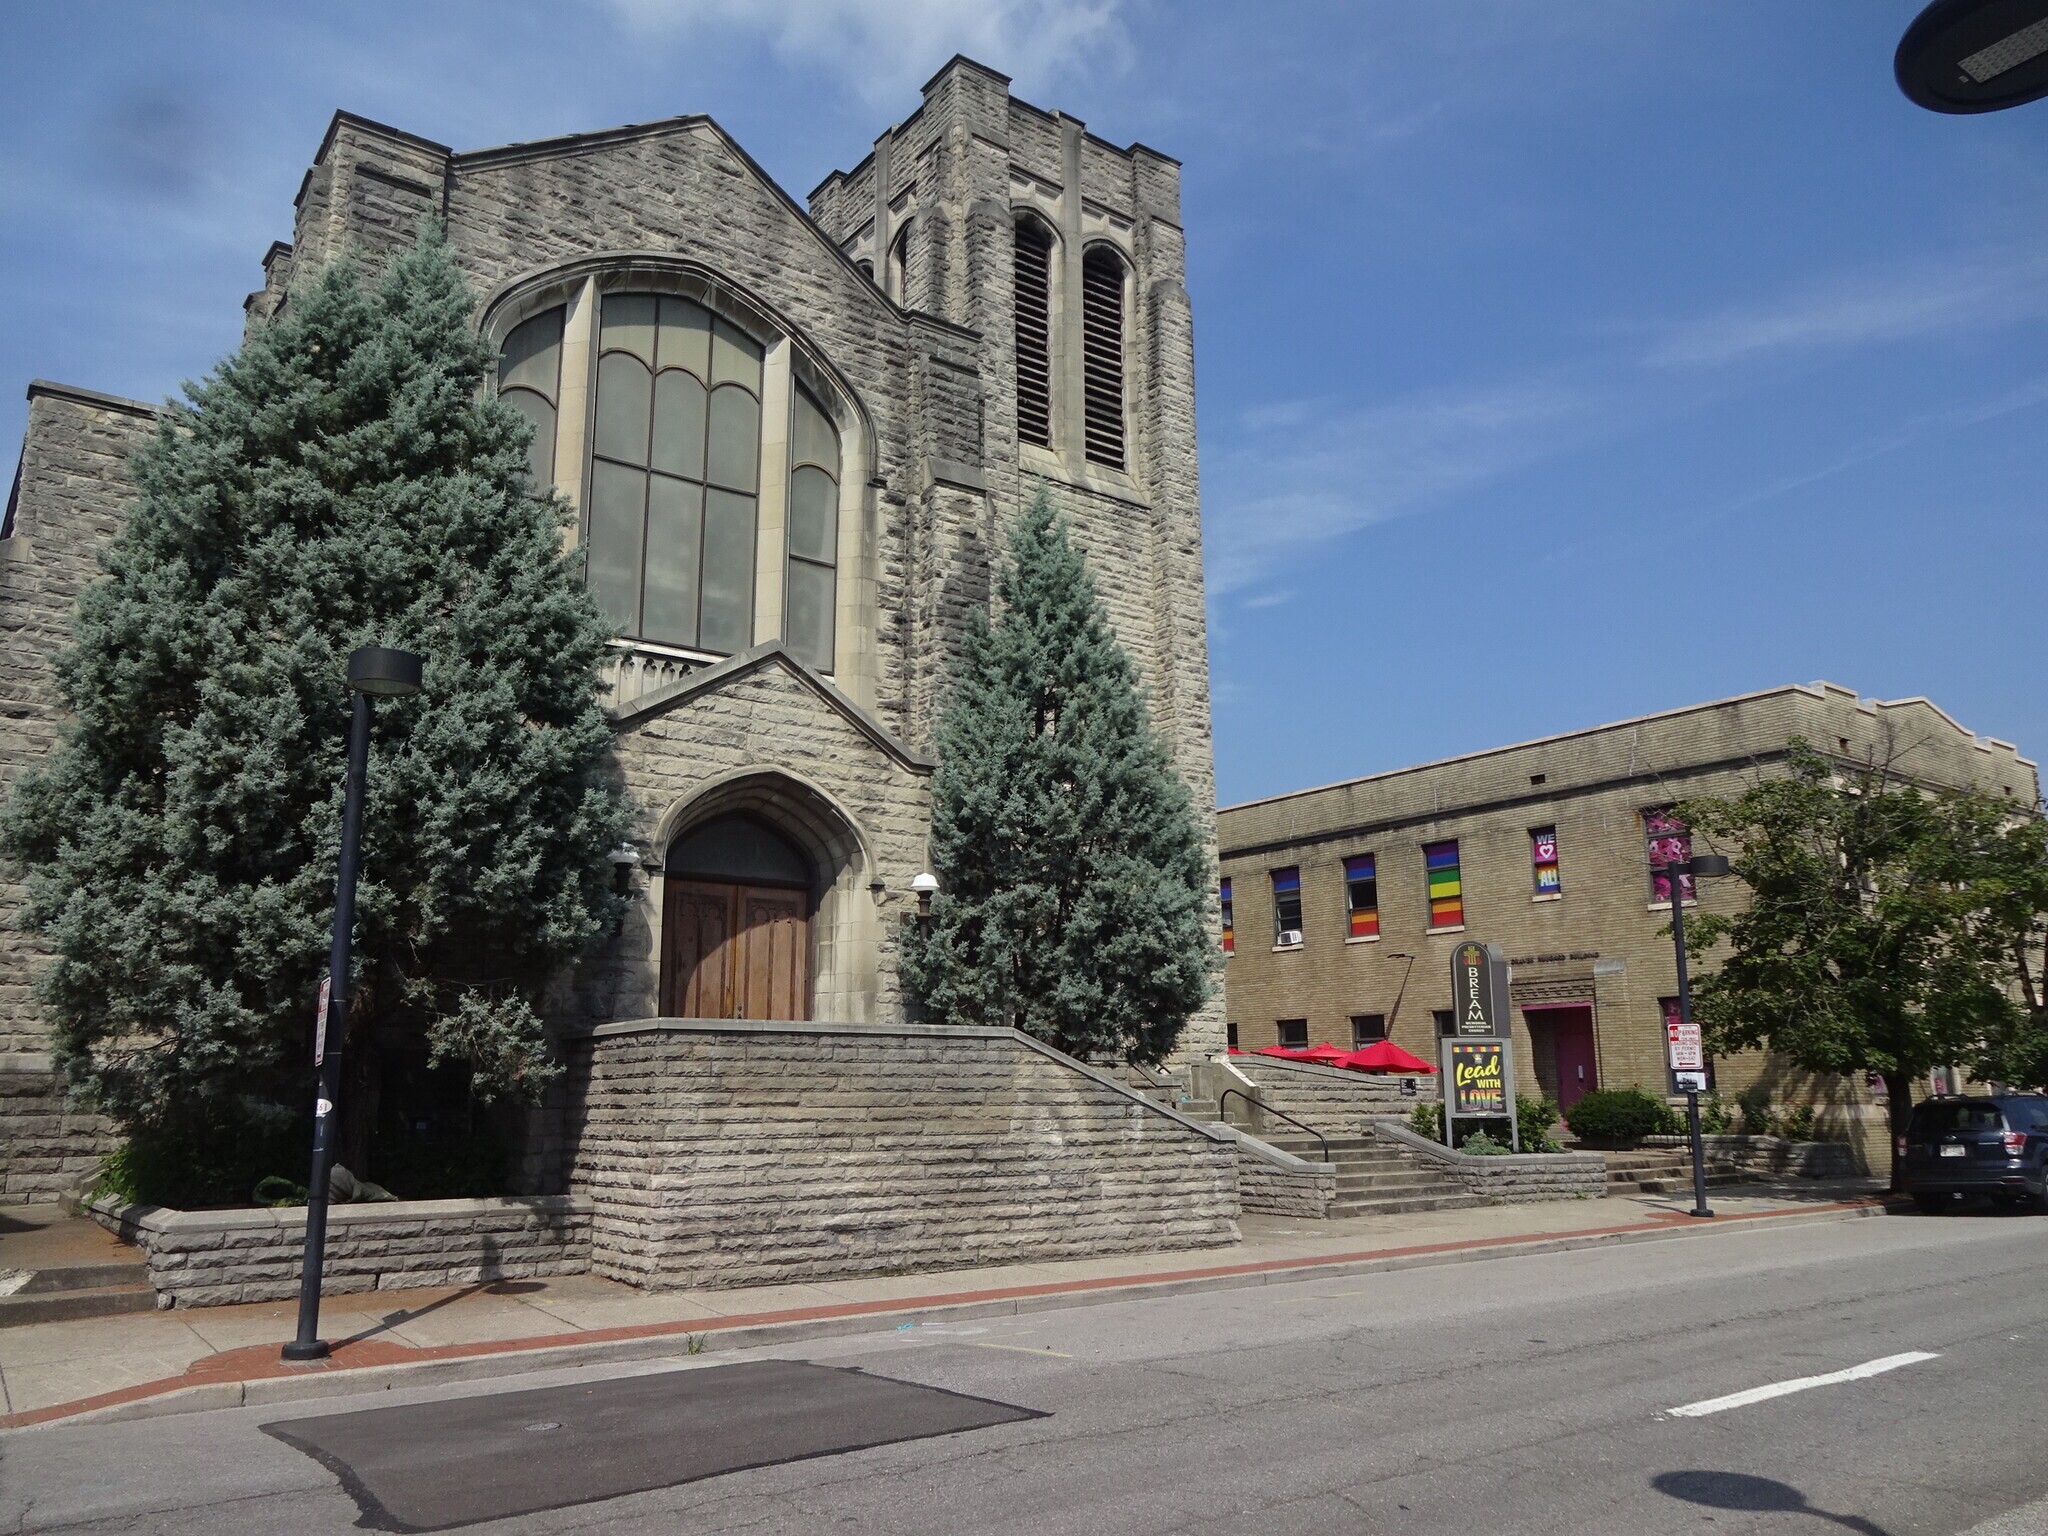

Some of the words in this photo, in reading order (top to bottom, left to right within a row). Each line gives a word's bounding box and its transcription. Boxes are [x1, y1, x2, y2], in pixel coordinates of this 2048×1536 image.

[1536, 833, 1555, 845] WE
[1540, 869, 1560, 887] ALL
[1468, 967, 1484, 1020] BREAM
[1670, 1029, 1678, 1038] NO
[1456, 1055, 1501, 1087] Lead
[1476, 1078, 1501, 1089] WITH
[1460, 1089, 1503, 1110] LOVE
